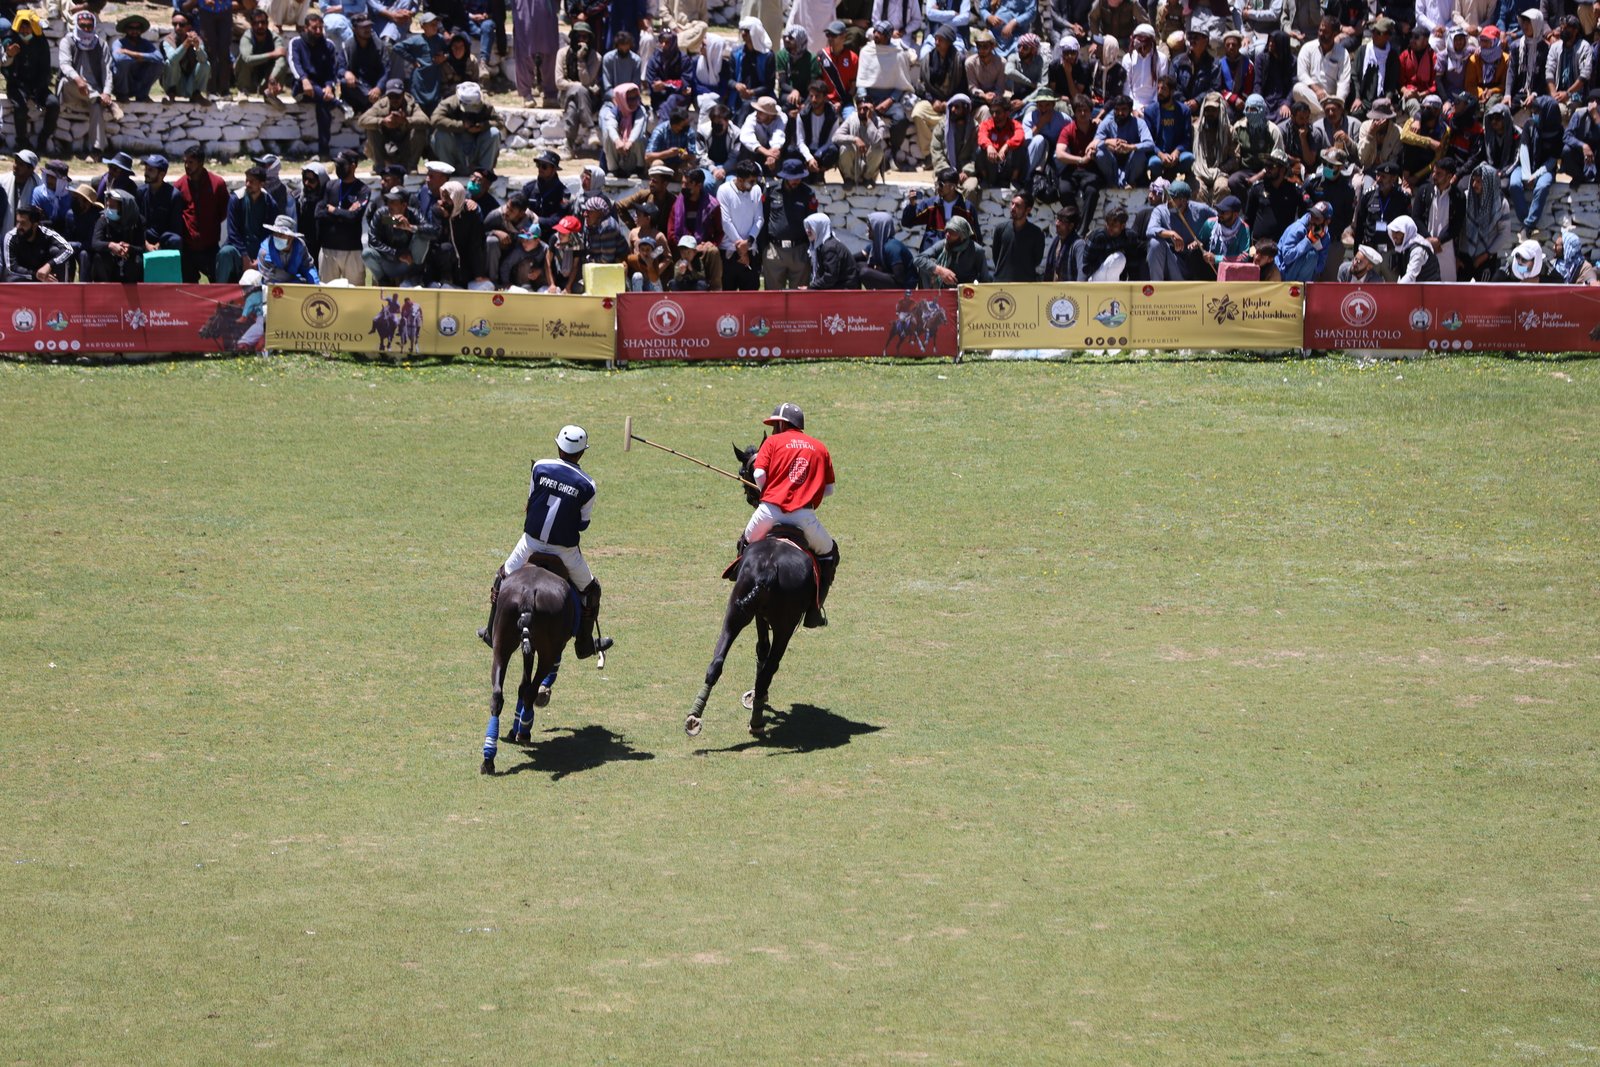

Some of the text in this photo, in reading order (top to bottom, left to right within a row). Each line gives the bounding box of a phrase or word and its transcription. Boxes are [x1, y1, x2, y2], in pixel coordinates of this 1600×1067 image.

[1242, 297, 1271, 309] Khyber
[967, 322, 1037, 330] SHANDUR POLO
[274, 330, 363, 342] SHANDUR POLO
[1314, 329, 1402, 339] SHANDUR POLO
[295, 341, 343, 351] FESTIVAL
[623, 338, 710, 348] SHANDUR POLO
[1334, 340, 1381, 348] FESTIVAL
[643, 348, 690, 358] FESTIVAL
[785, 443, 816, 451] CHITRAL
[539, 476, 580, 498] UPPER GHIZER
[539, 494, 562, 545] 1
